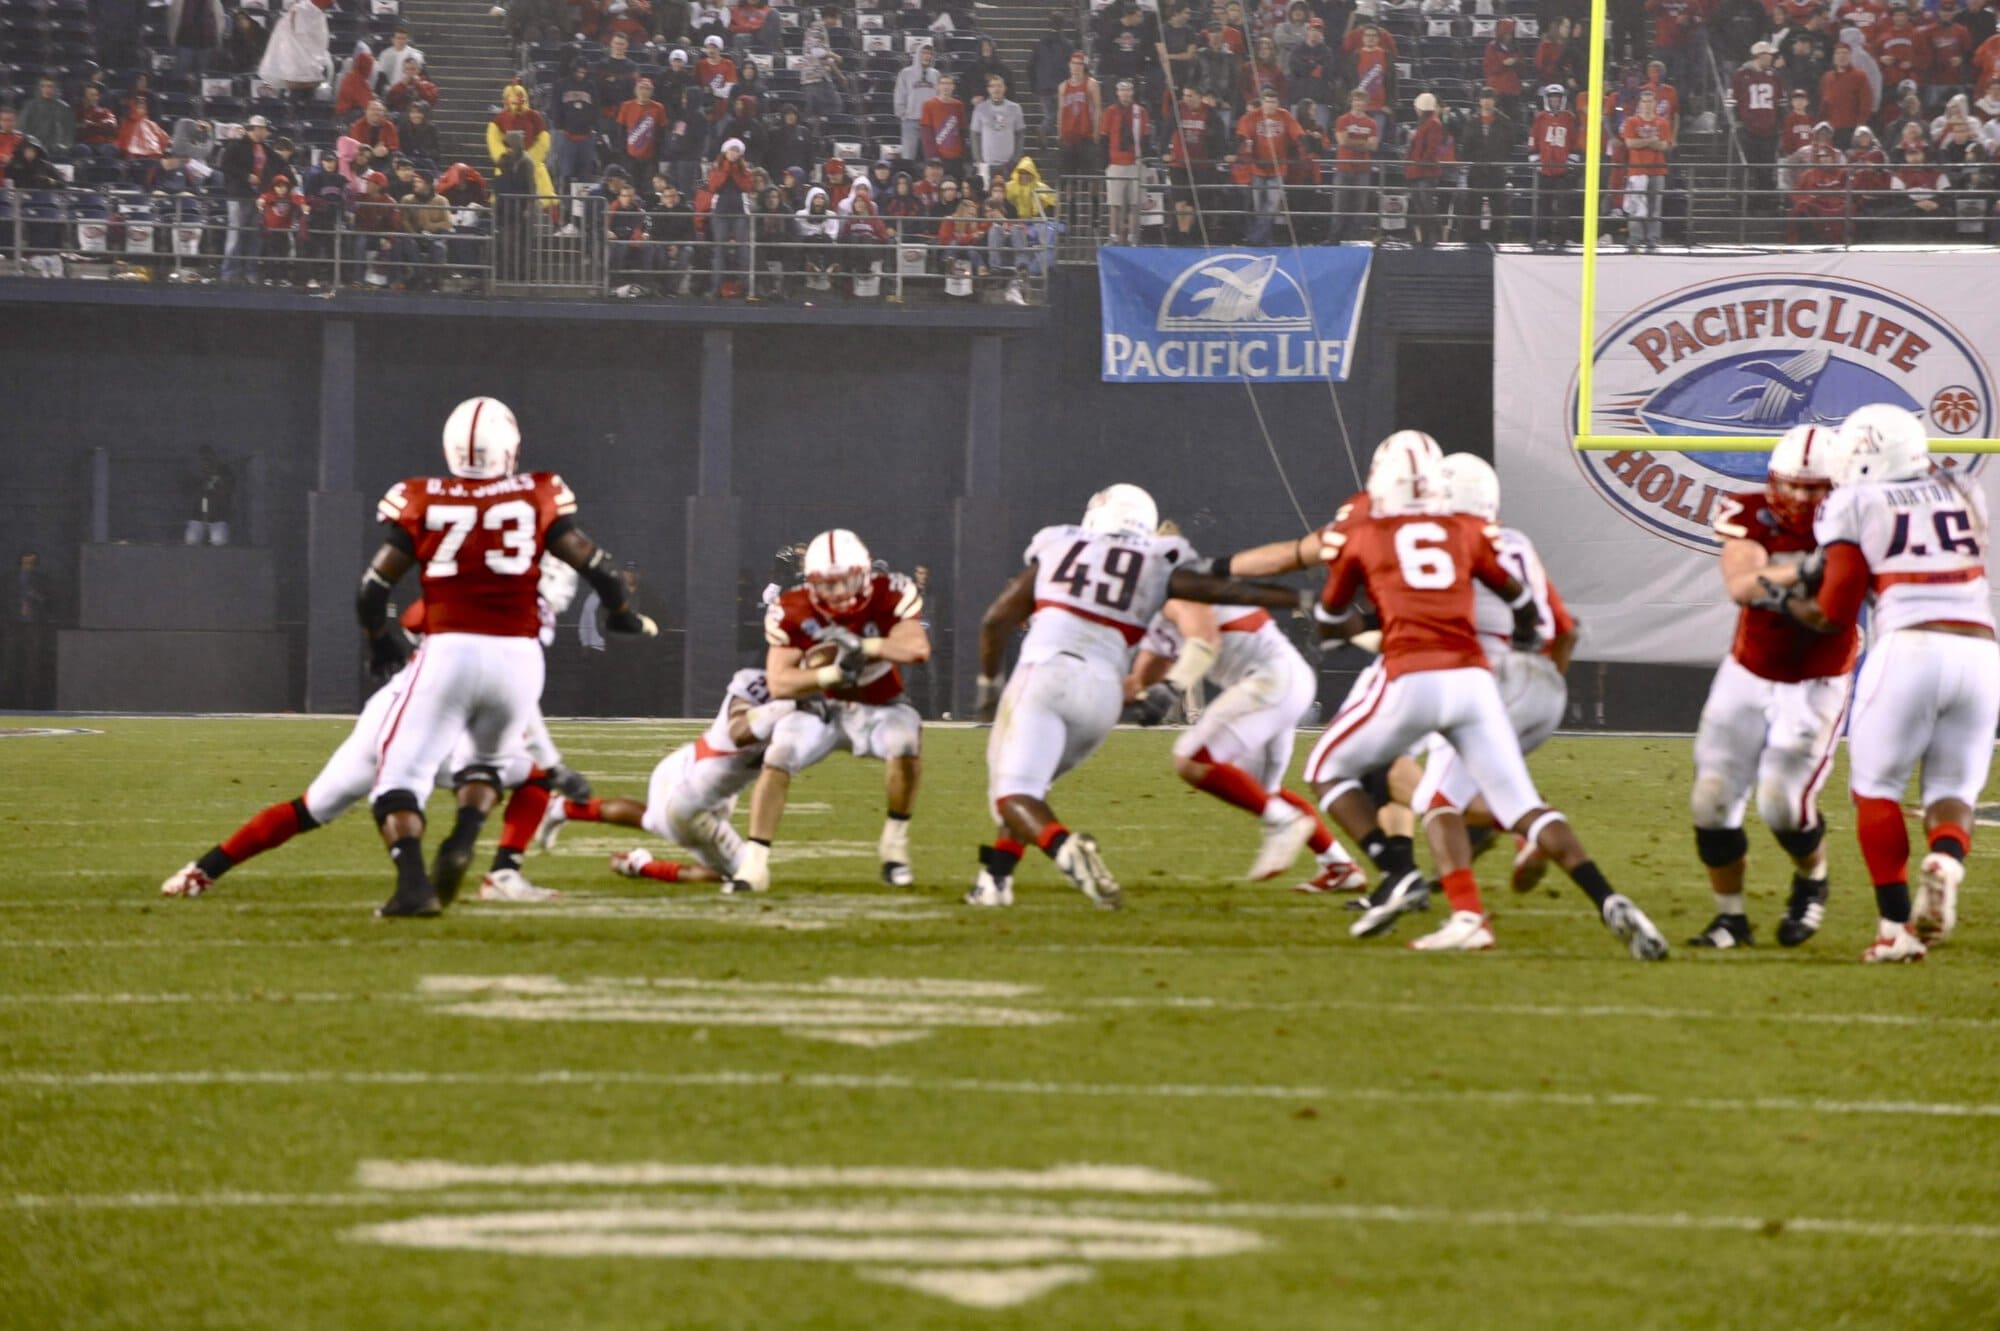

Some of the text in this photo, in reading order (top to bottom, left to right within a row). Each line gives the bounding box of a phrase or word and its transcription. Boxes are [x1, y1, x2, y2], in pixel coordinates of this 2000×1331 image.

[1749, 83, 1774, 109] 12
[1104, 334, 1348, 378] PACIFIC LIF
[1629, 296, 1931, 374] PACIFIC LIFE
[1604, 450, 1728, 526] HOLI
[425, 500, 536, 577] 73
[1394, 522, 1455, 589] 6
[1051, 540, 1144, 612] 49
